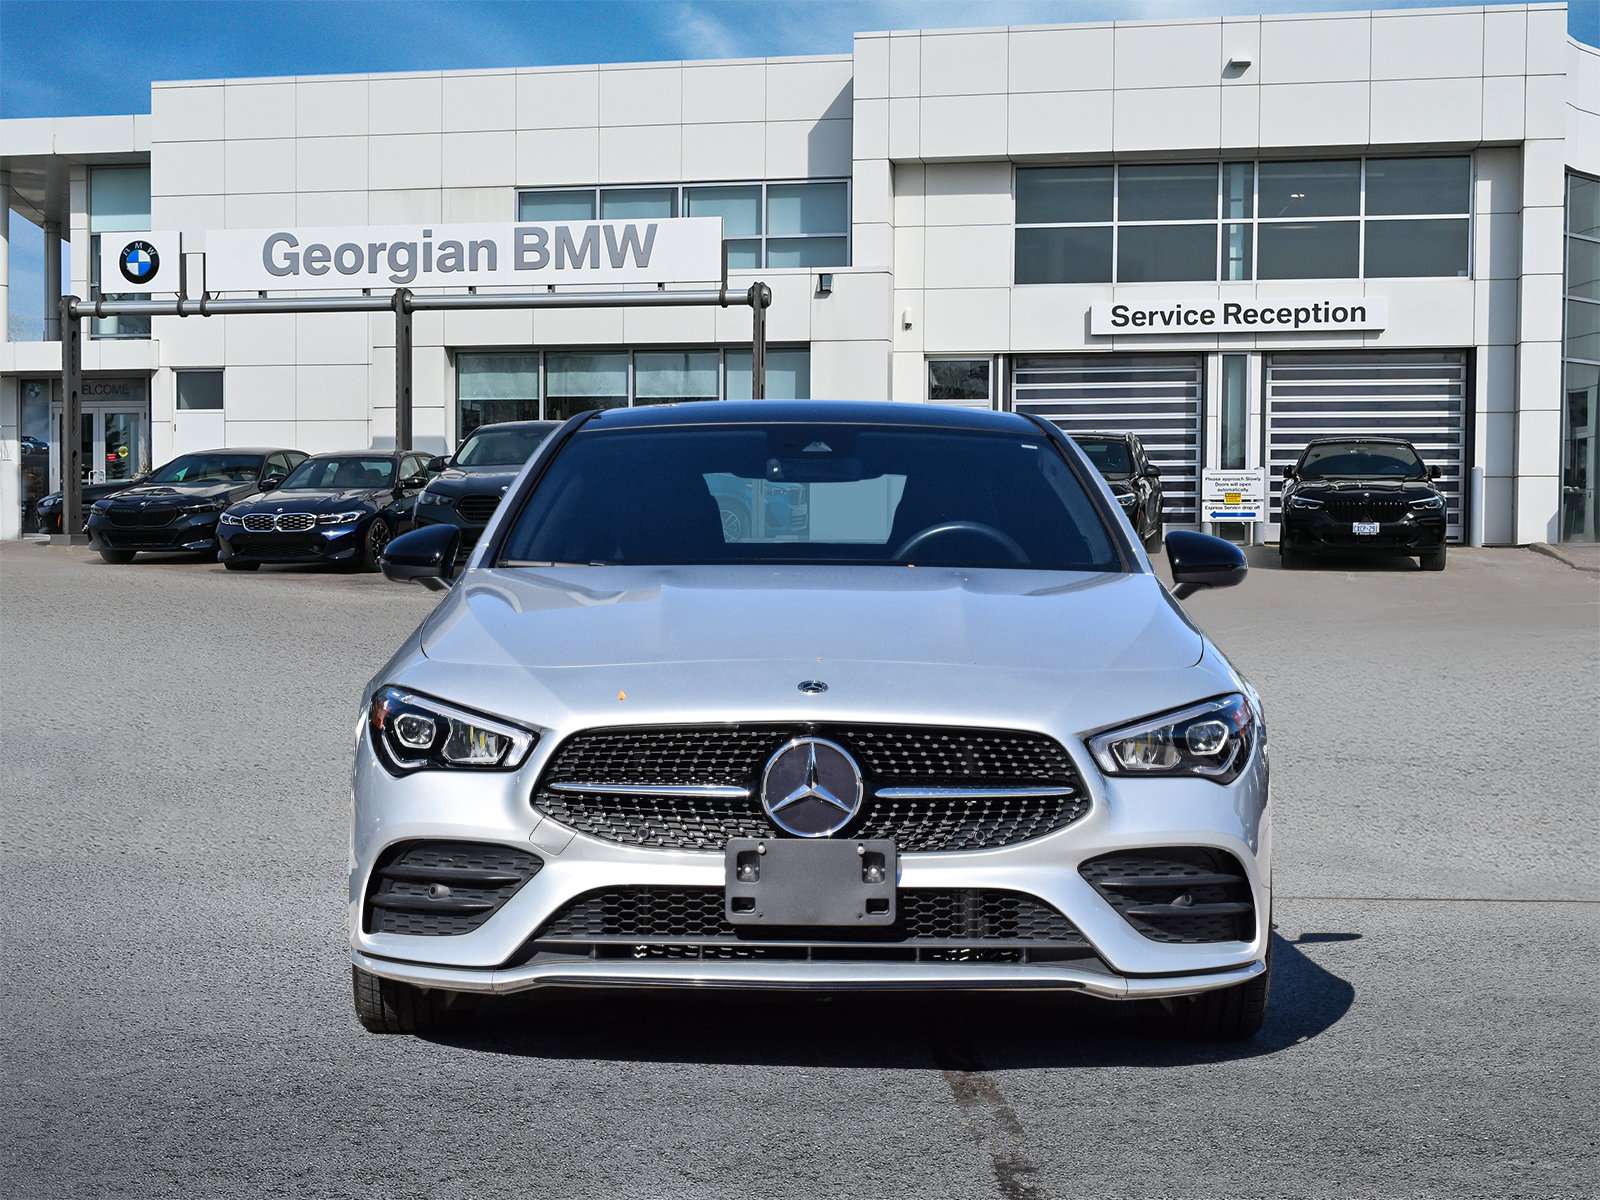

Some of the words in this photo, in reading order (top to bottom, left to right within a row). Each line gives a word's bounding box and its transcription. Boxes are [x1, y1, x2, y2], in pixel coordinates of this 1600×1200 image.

[122, 242, 157, 256] BMW
[262, 229, 498, 284] Georgian
[513, 223, 658, 271] BMW
[1111, 304, 1216, 327] Service
[1223, 301, 1367, 328] Reception
[81, 383, 129, 395] ELCOME
